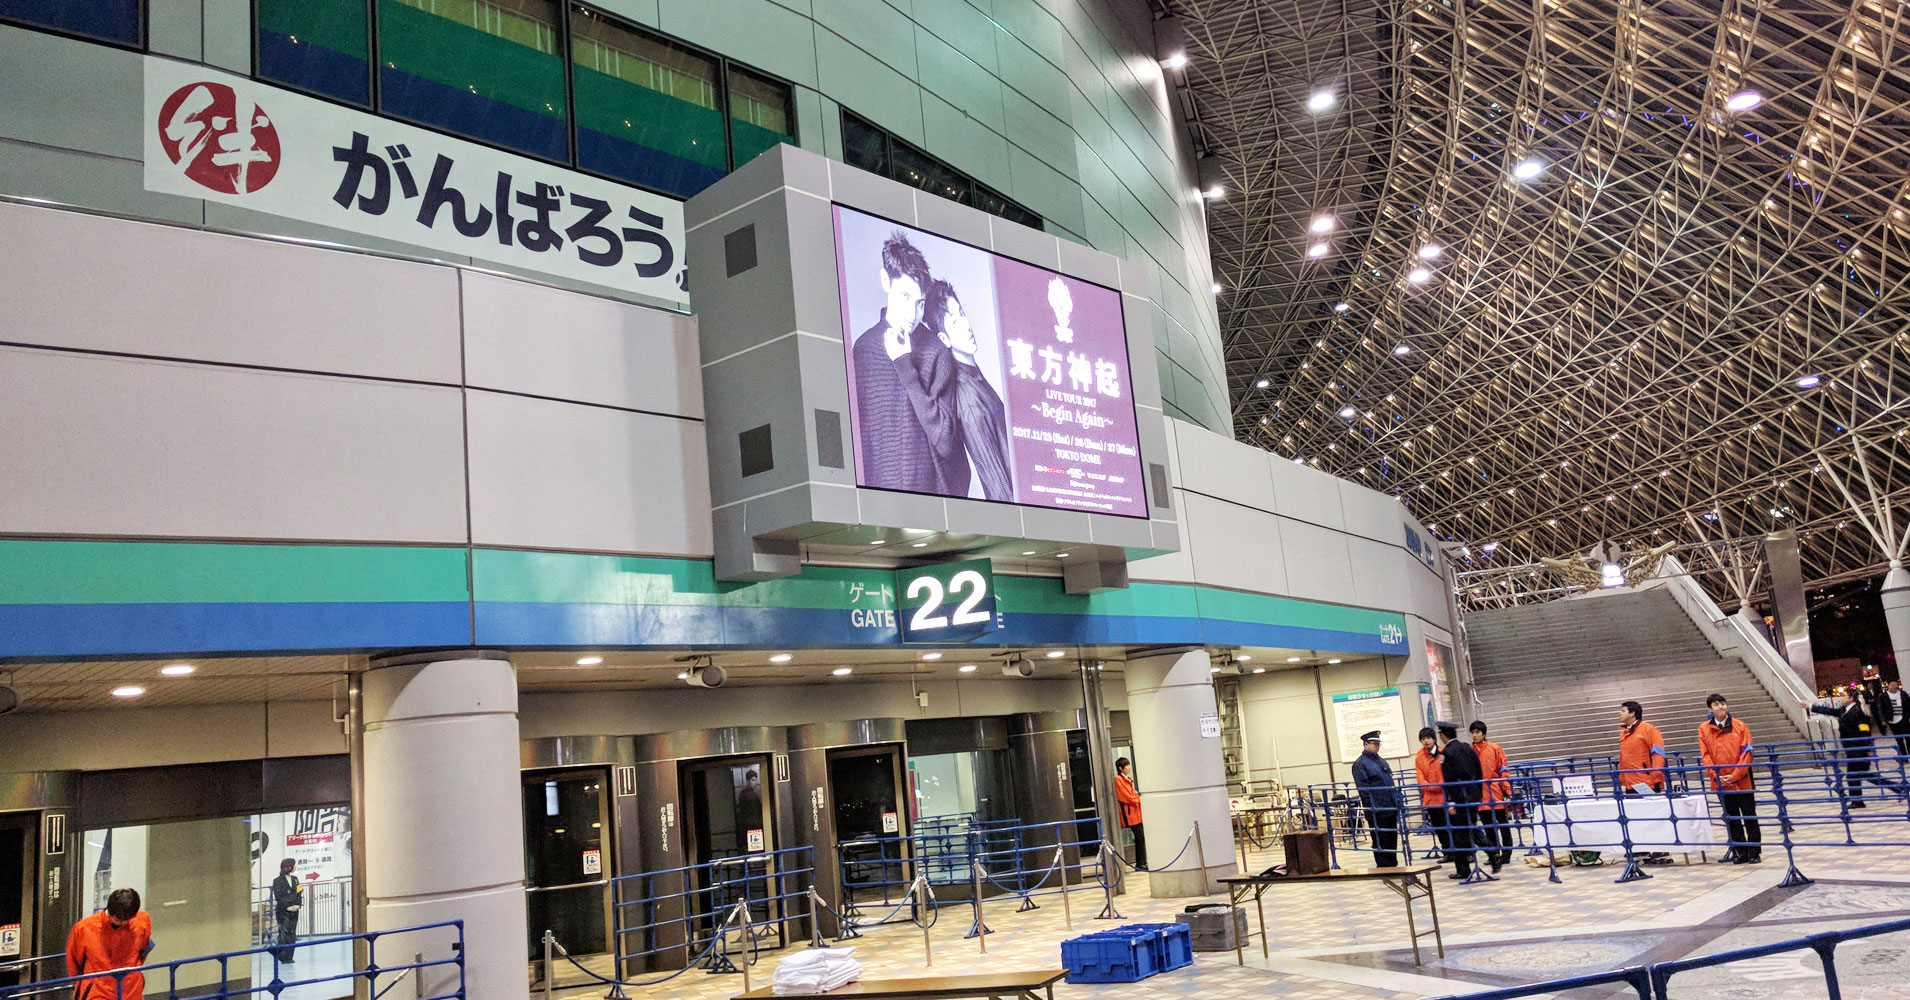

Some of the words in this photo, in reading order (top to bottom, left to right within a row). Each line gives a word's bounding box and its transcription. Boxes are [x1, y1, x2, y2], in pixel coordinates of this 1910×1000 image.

[332, 131, 673, 277] がんばろう
[1007, 338, 1120, 398] 東方神起
[1045, 388, 1063, 402] LIVE
[1063, 392, 1082, 405] TOUR
[1054, 448, 1079, 462] TOKYO
[1079, 452, 1101, 465] DOME
[849, 582, 895, 605] ゲート
[907, 570, 990, 631] 22
[851, 609, 896, 628] GATE
[1388, 624, 1399, 645] 21
